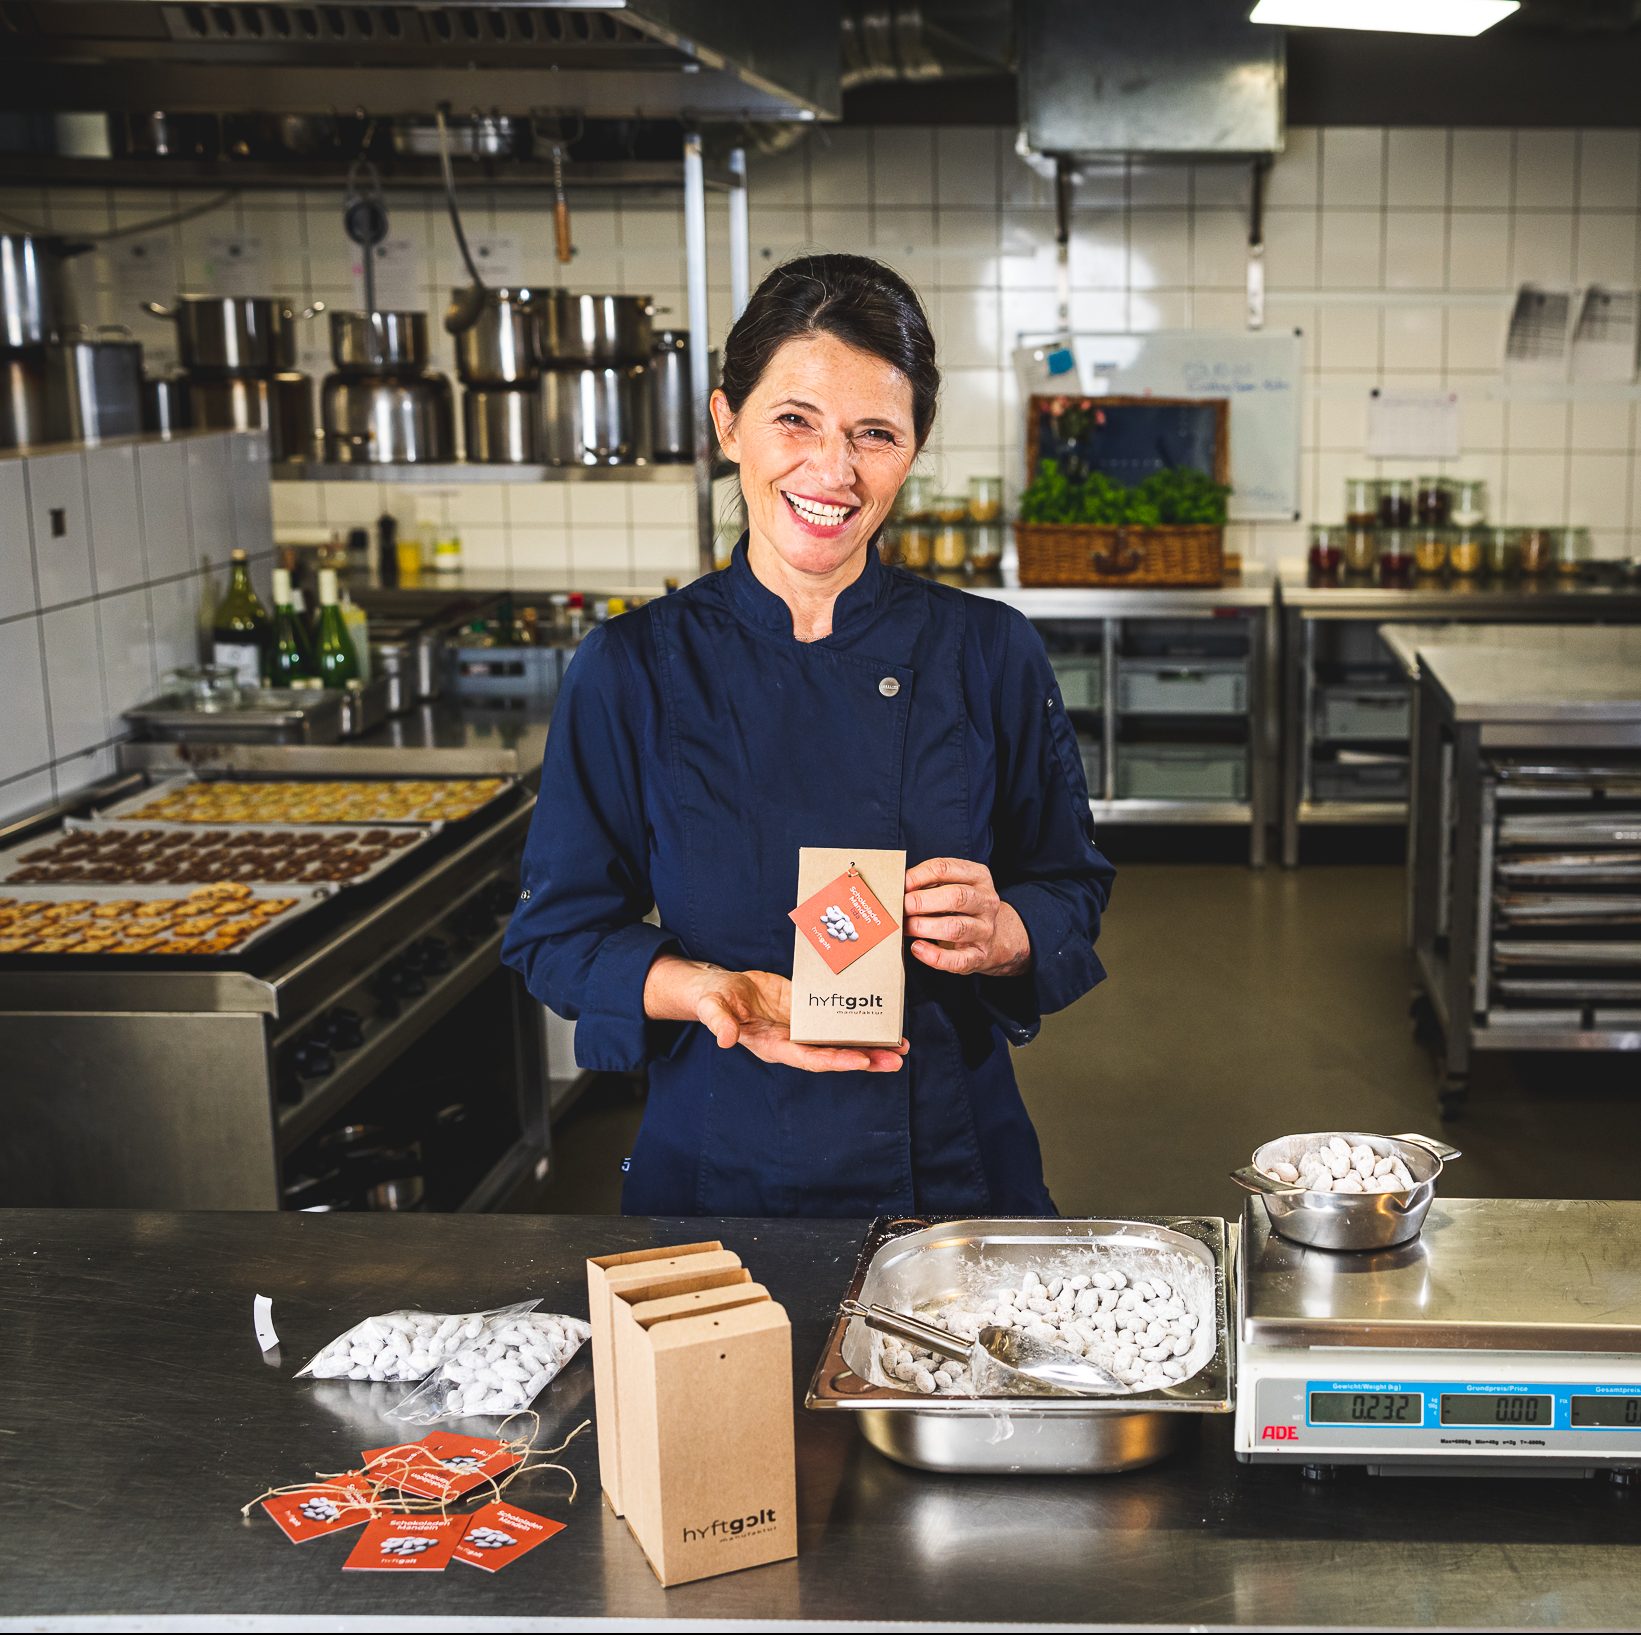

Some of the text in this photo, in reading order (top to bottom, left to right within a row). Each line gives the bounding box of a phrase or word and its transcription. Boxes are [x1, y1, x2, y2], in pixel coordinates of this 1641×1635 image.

[848, 896, 872, 924] Mandeln
[849, 885, 882, 926] Schokoladen
[1466, 1384, 1529, 1393] Grundpreis/Price
[1352, 1395, 1409, 1420] 0.232
[1496, 1397, 1539, 1422] 0.00
[1262, 1425, 1299, 1440] ADE
